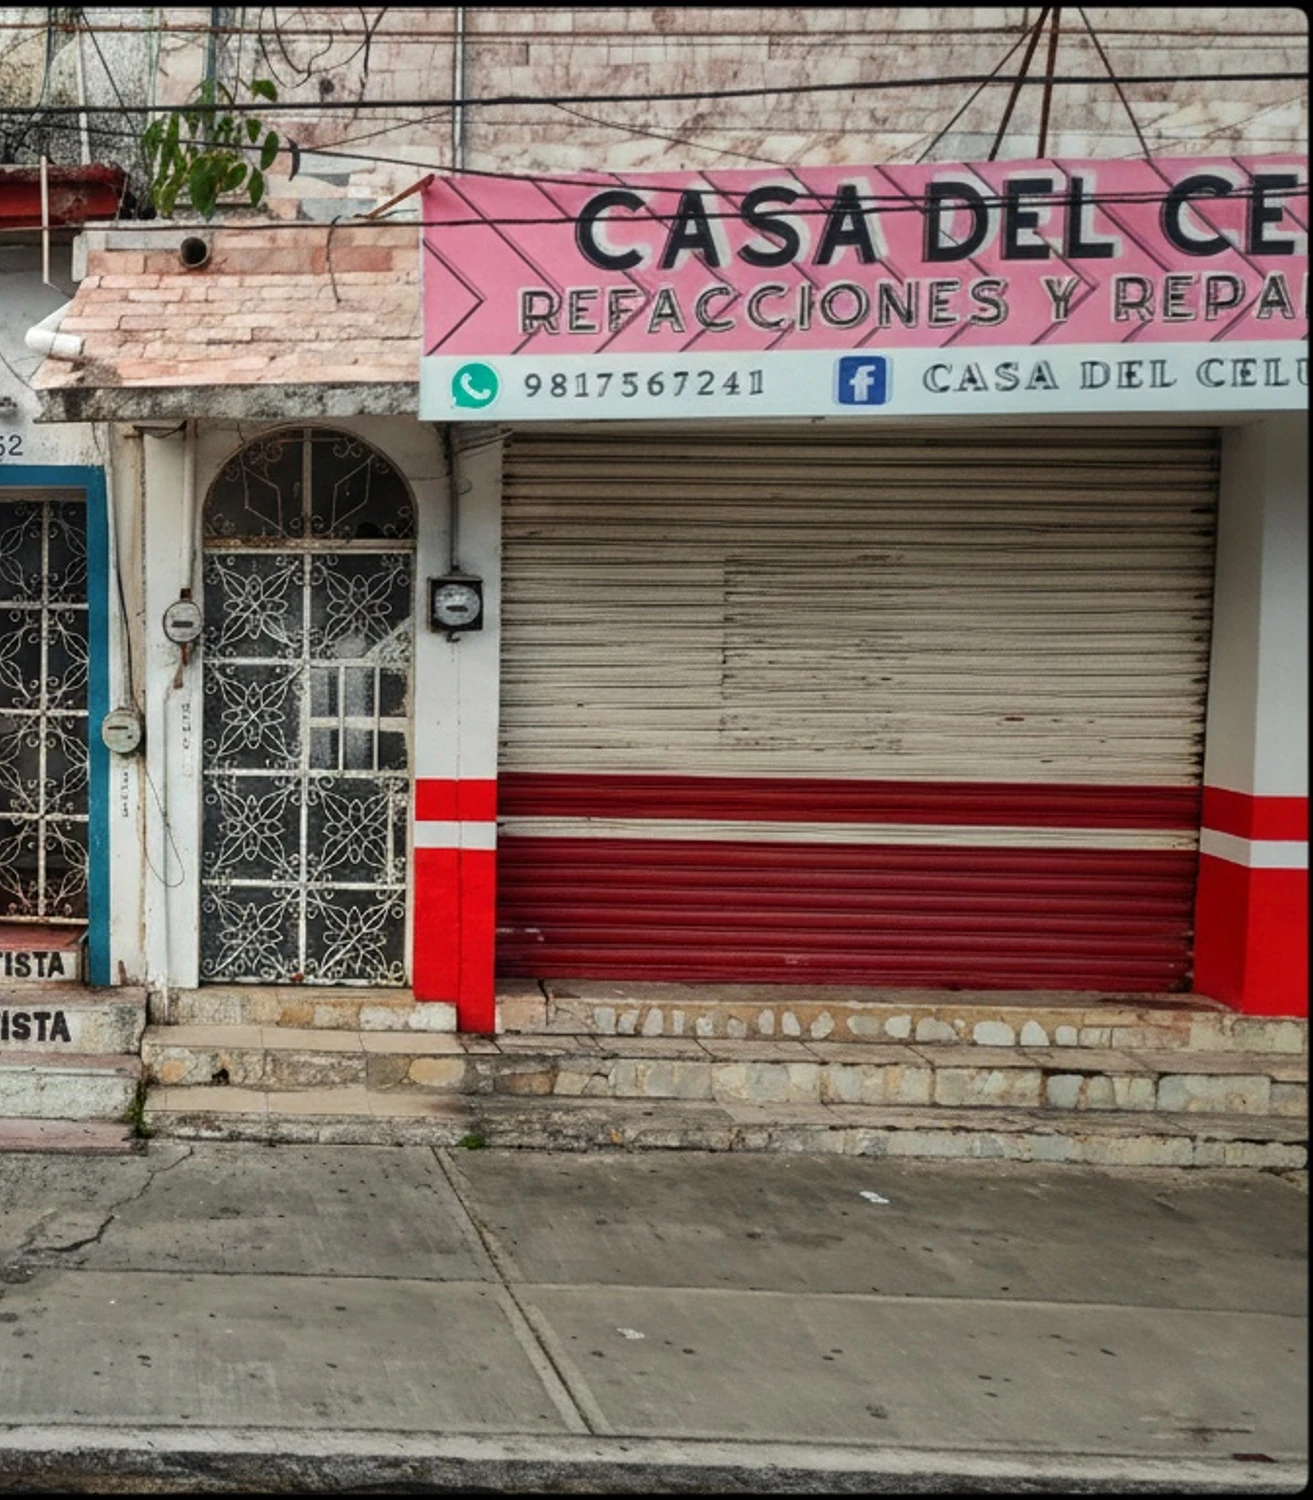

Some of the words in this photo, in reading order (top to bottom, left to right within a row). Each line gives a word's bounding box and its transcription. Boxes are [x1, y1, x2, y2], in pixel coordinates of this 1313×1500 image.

[575, 184, 878, 271] CASA
[922, 176, 1114, 263] DEL
[519, 276, 1010, 335] REFACCIONES
[1042, 274, 1082, 323] Y
[1114, 272, 1308, 324] REPA
[524, 369, 764, 399] 9817567241
[922, 360, 1059, 393] CASA
[1079, 359, 1177, 391] DEL
